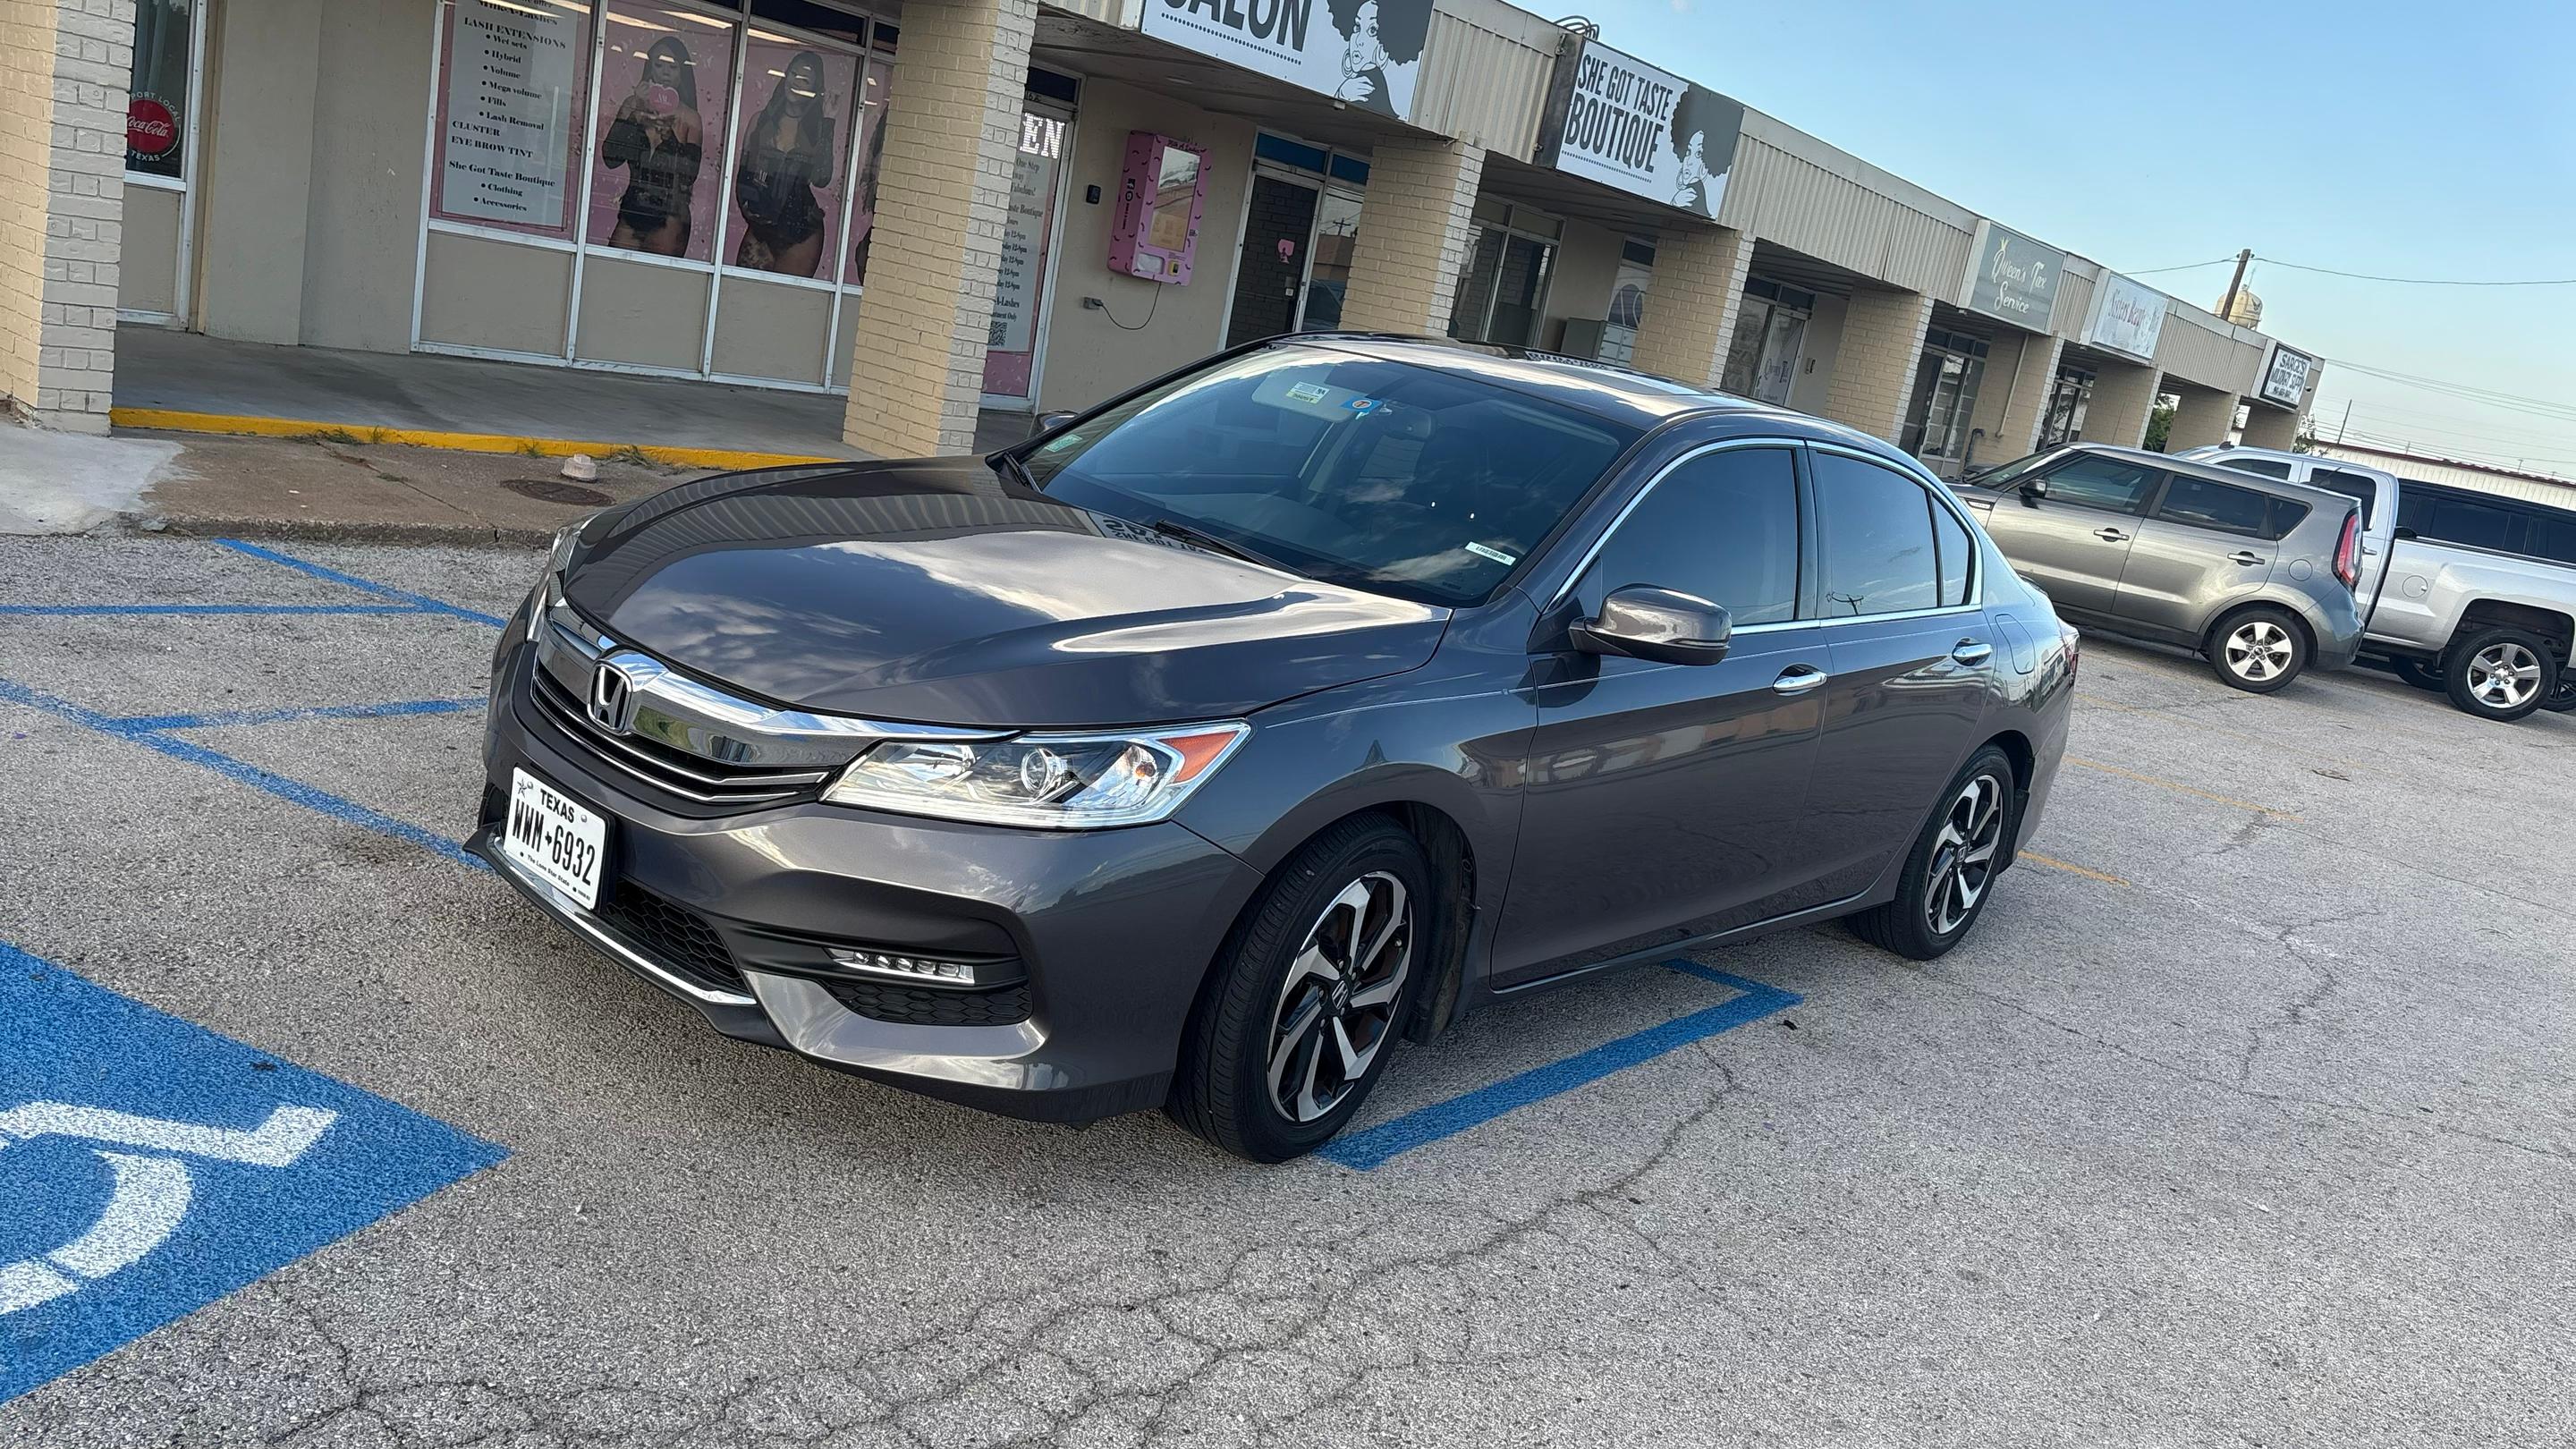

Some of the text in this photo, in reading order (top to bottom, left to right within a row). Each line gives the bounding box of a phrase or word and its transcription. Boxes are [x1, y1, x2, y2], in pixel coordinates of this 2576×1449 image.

[464, 17, 567, 49] LASH EXTENSIONS
[493, 35, 529, 50] Wet sets
[492, 50, 522, 64] Hybrid
[491, 66, 521, 80] Volume
[489, 81, 543, 99] Mega volume
[1577, 54, 1674, 122] SHE GOT TASTE
[130, 91, 182, 123] PORT LOCAL
[487, 97, 507, 107] Fills
[452, 120, 501, 137] CLUSTER
[487, 112, 545, 131] Lash Removal
[1563, 92, 1665, 174] BOUTIQUE
[451, 135, 535, 159] EYE BROW TINT
[1019, 112, 1066, 159] EN
[131, 150, 160, 162] TEXAS
[449, 160, 556, 188] She Got Taste Boutique
[487, 183, 523, 197] Clothing
[480, 198, 528, 212] Accessories
[2028, 260, 2047, 297] Tax
[1994, 280, 2029, 314] Service
[539, 788, 575, 824] TEXAS
[512, 798, 596, 886] WWM 6932
